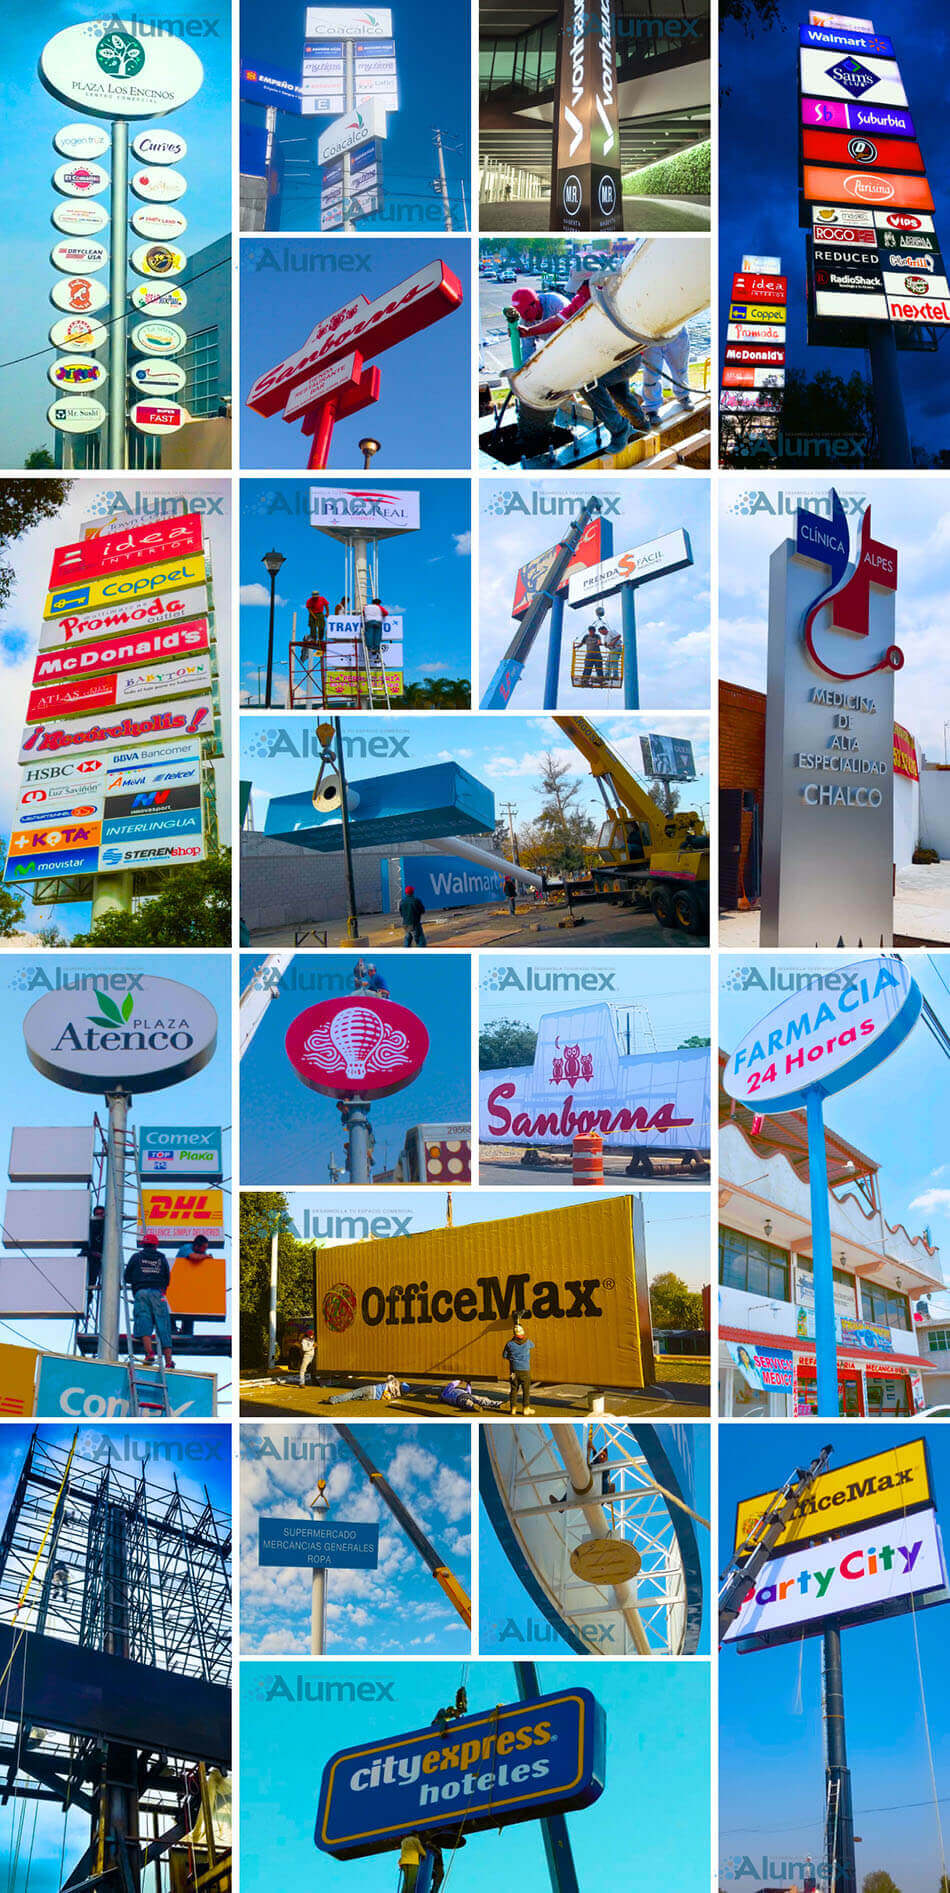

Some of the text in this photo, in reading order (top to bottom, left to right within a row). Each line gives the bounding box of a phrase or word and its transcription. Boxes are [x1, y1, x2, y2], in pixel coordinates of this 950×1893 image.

[315, 24, 384, 35] Coacalco
[807, 30, 868, 48] Walmart
[569, 0, 585, 107] vonhau
[130, 86, 175, 100] ENCINOS
[856, 111, 906, 129] Suburbia
[138, 138, 182, 154] Curves
[322, 128, 369, 159] Coacalco
[815, 227, 855, 241] ROGO
[814, 250, 879, 264] REDUCED
[890, 302, 950, 321] nextel
[252, 280, 436, 399] Sanborns
[726, 349, 784, 361] McDonald's
[149, 414, 175, 423] FAST
[102, 526, 194, 556] idea
[800, 525, 846, 554] CLÍNICA
[863, 551, 894, 573] ALPES
[583, 567, 620, 588] PRENDA
[58, 597, 186, 643] Promoda
[38, 629, 203, 676] McDonald's
[811, 688, 878, 714] MEDICINA
[837, 714, 854, 731] DE
[830, 734, 861, 752] ALTA
[113, 744, 193, 764] BBVA Bancomer
[798, 752, 888, 776] ESPECIALIDAD
[26, 764, 75, 782] HSBC
[803, 783, 883, 808] CHALCO
[105, 817, 197, 837] INTERLINGUA
[37, 858, 85, 871] movistar
[429, 872, 500, 897] Walmart
[133, 1018, 190, 1030] PLAZA
[733, 966, 901, 1076] FARMACIA
[50, 1021, 194, 1051] Atenco
[746, 1018, 876, 1095] 24 Horas
[487, 1082, 695, 1137] Sanborns
[146, 1130, 217, 1145] Comex
[148, 1195, 212, 1219] DHL
[283, 1527, 357, 1540] SUPERMERCADO
[323, 1541, 375, 1553] GENERALES
[307, 1553, 332, 1564] ROPA
[419, 1758, 550, 1807] hoteles
